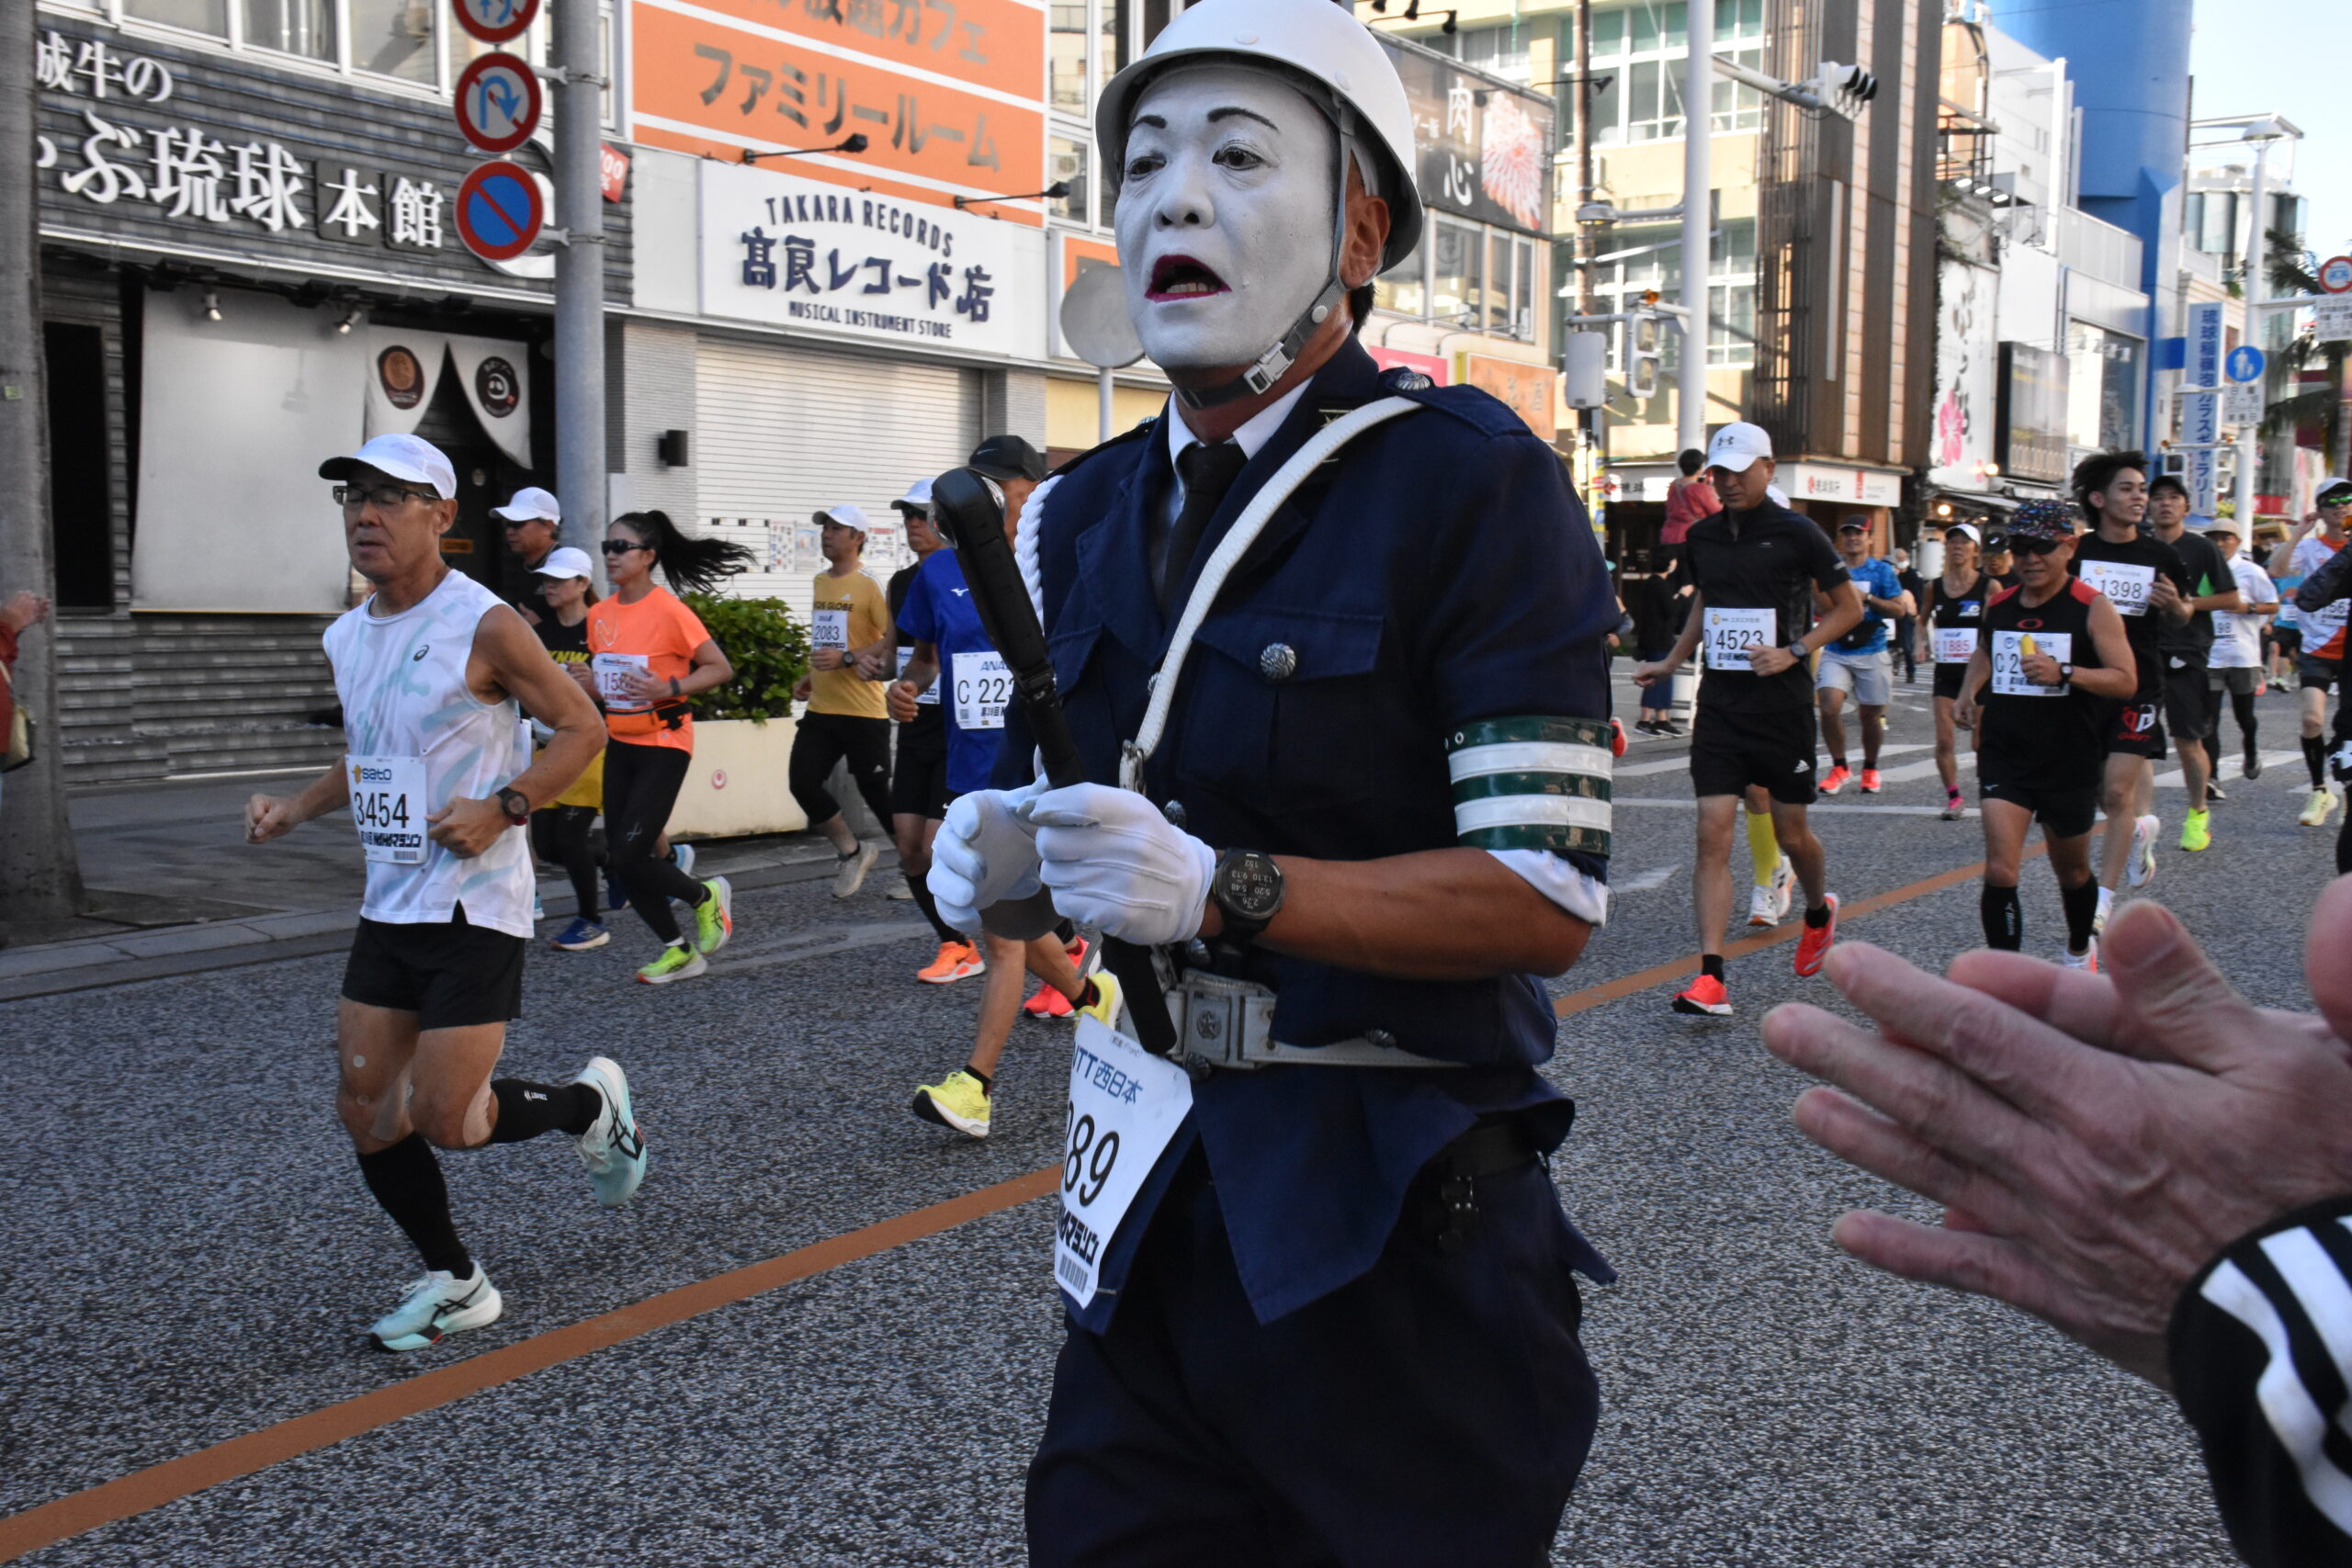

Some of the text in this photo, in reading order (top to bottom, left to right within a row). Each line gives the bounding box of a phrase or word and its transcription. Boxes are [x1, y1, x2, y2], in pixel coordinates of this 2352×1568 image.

[694, 42, 1001, 173] ファミリールーム
[1443, 76, 1475, 206] 肉心
[765, 195, 954, 257] TAKARA RECORDS
[789, 300, 952, 338] MUSICAL INSTRUMENT STORE
[1716, 628, 1764, 650] 4523
[957, 680, 970, 705] C
[354, 791, 410, 829] 3454
[1062, 1100, 1119, 1208] 89
